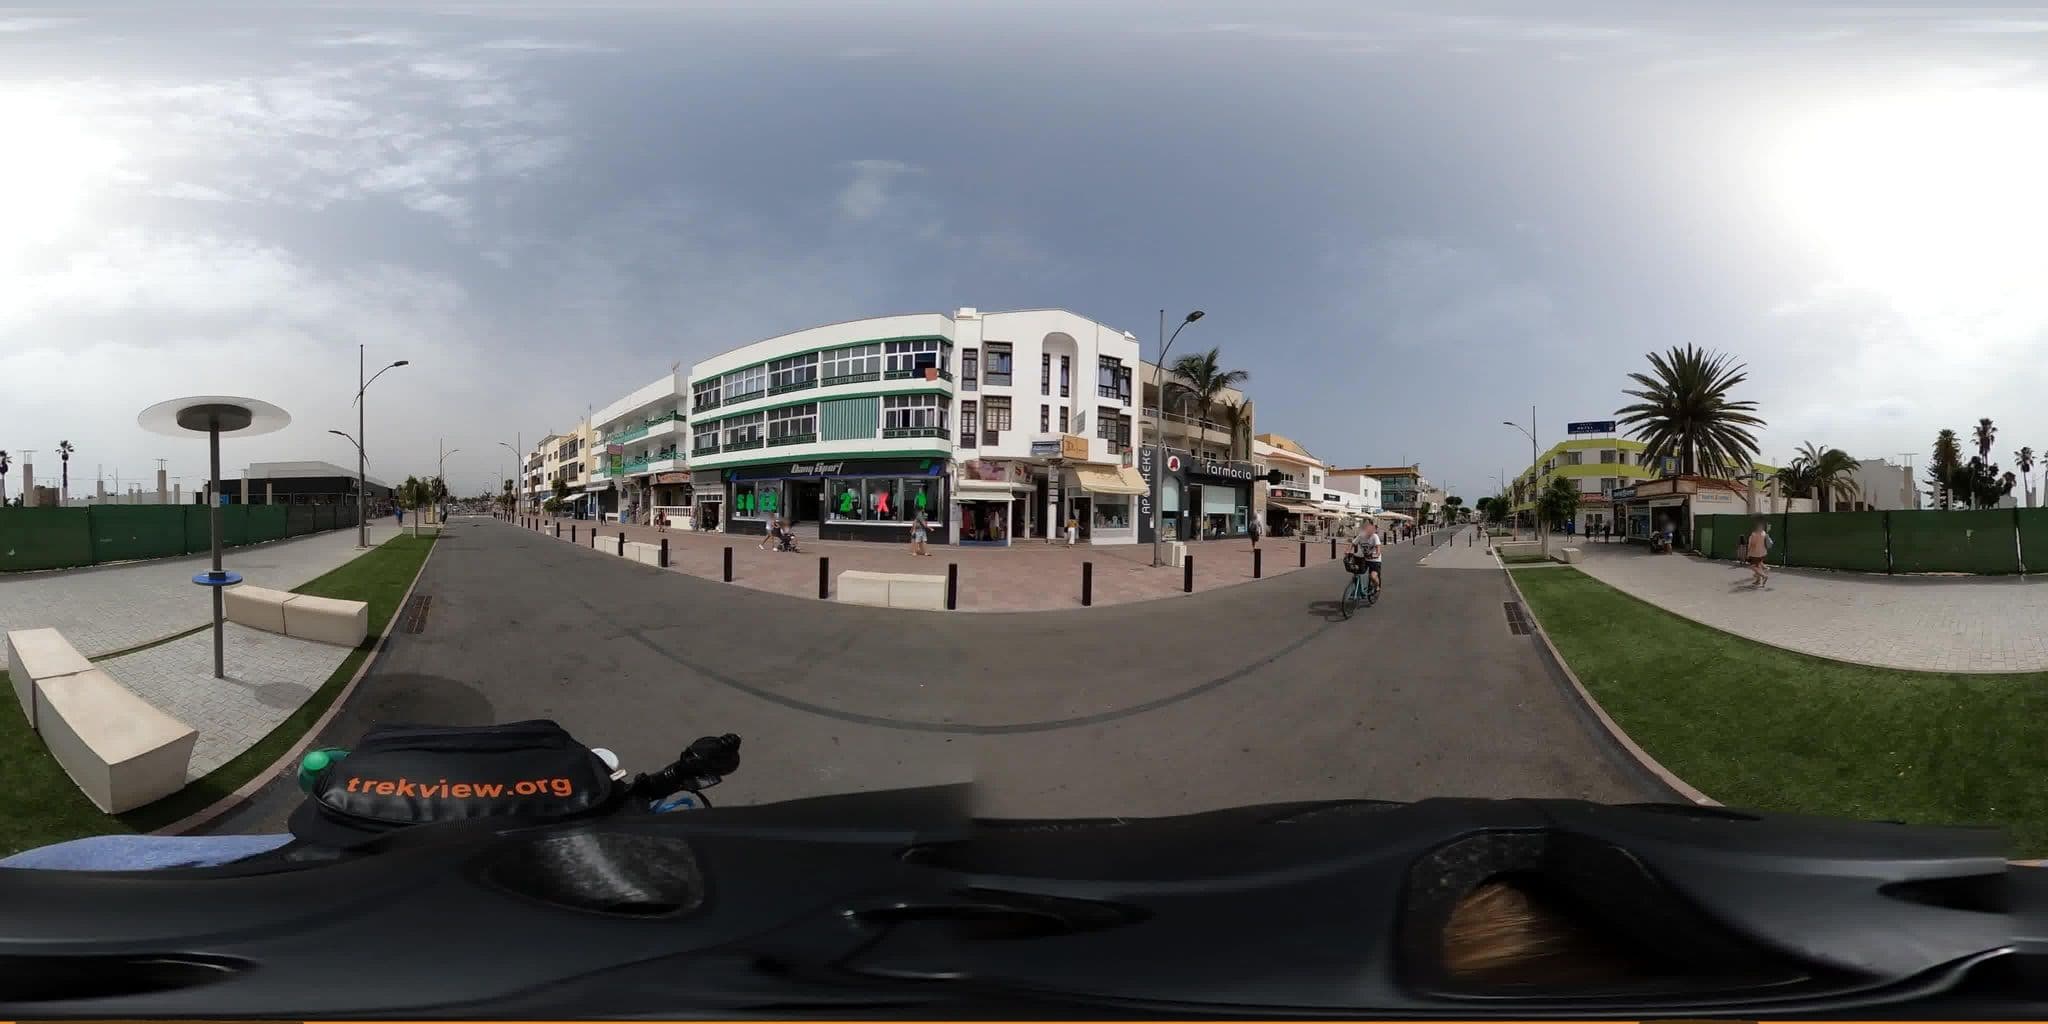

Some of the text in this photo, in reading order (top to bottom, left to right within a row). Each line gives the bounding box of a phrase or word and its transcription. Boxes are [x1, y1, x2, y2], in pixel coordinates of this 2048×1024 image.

[1206, 461, 1252, 480] farmacia
[1141, 449, 1151, 514] APHEKE
[347, 777, 573, 798] trekview.org
